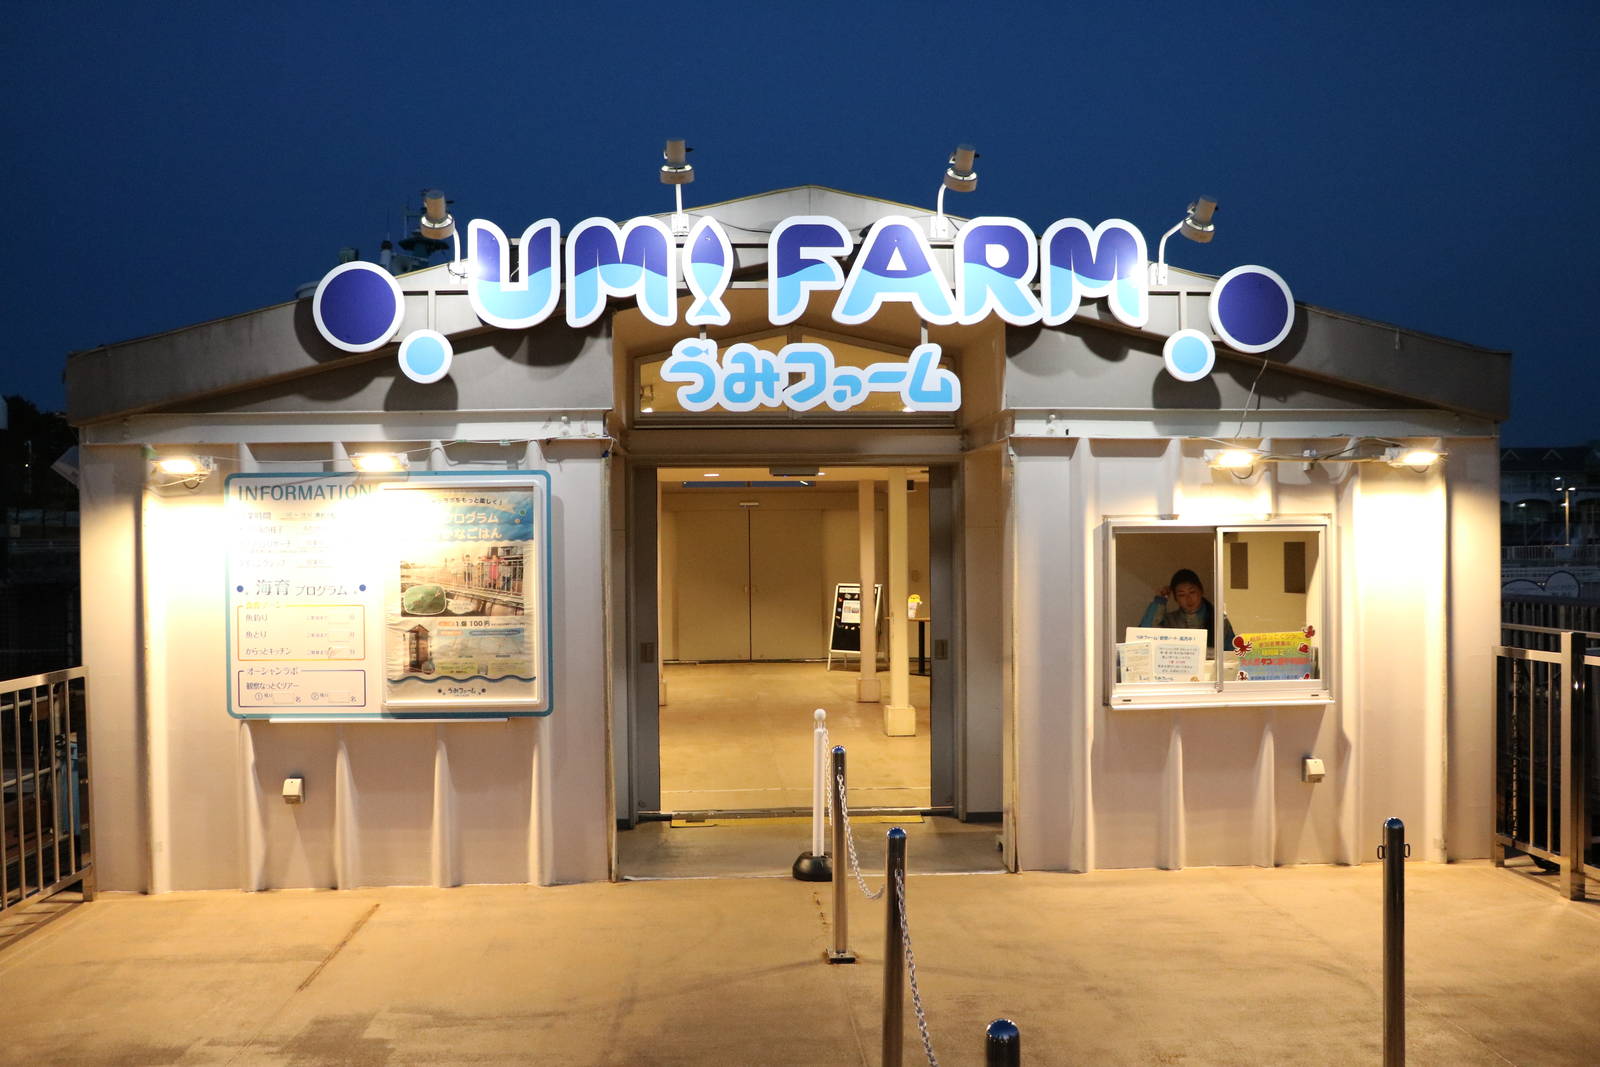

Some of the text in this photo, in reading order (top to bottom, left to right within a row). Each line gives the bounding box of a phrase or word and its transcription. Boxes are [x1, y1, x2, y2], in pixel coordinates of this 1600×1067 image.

[768, 216, 1148, 327] FARM
[660, 338, 961, 411] うみファーム
[238, 484, 371, 501] INFORMATION
